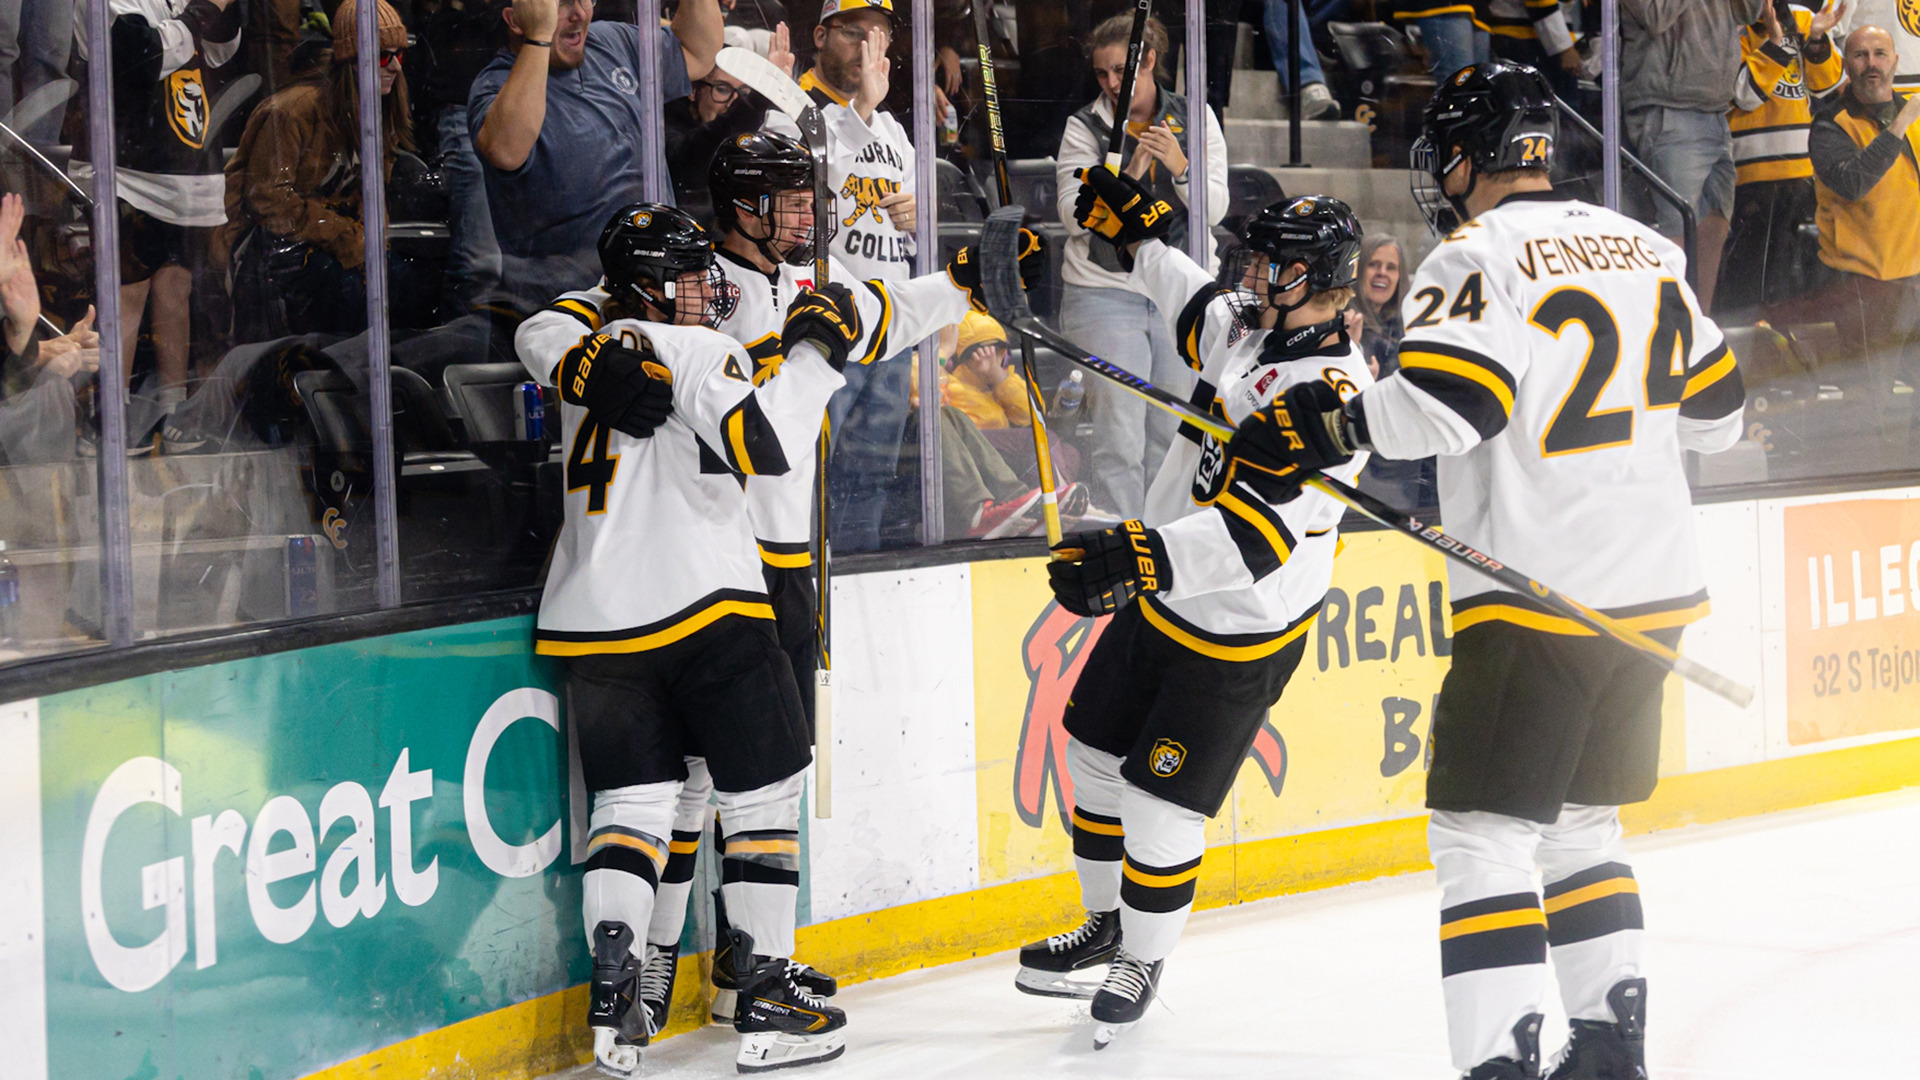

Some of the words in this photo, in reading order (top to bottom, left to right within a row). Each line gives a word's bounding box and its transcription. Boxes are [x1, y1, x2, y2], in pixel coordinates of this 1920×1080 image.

[1522, 137, 1547, 161] 24
[844, 229, 907, 263] COLLE
[1404, 271, 1489, 331] 24
[572, 333, 614, 398] BAUE
[1286, 326, 1316, 347] CCM
[1526, 277, 1695, 459] 24
[566, 409, 622, 516] 4
[1420, 528, 1504, 573] BAUER
[1317, 580, 1453, 673] REAL
[1812, 653, 1842, 698] 32
[1847, 650, 1863, 693] S
[1867, 645, 1920, 694] Tejo
[80, 747, 439, 993] Great
